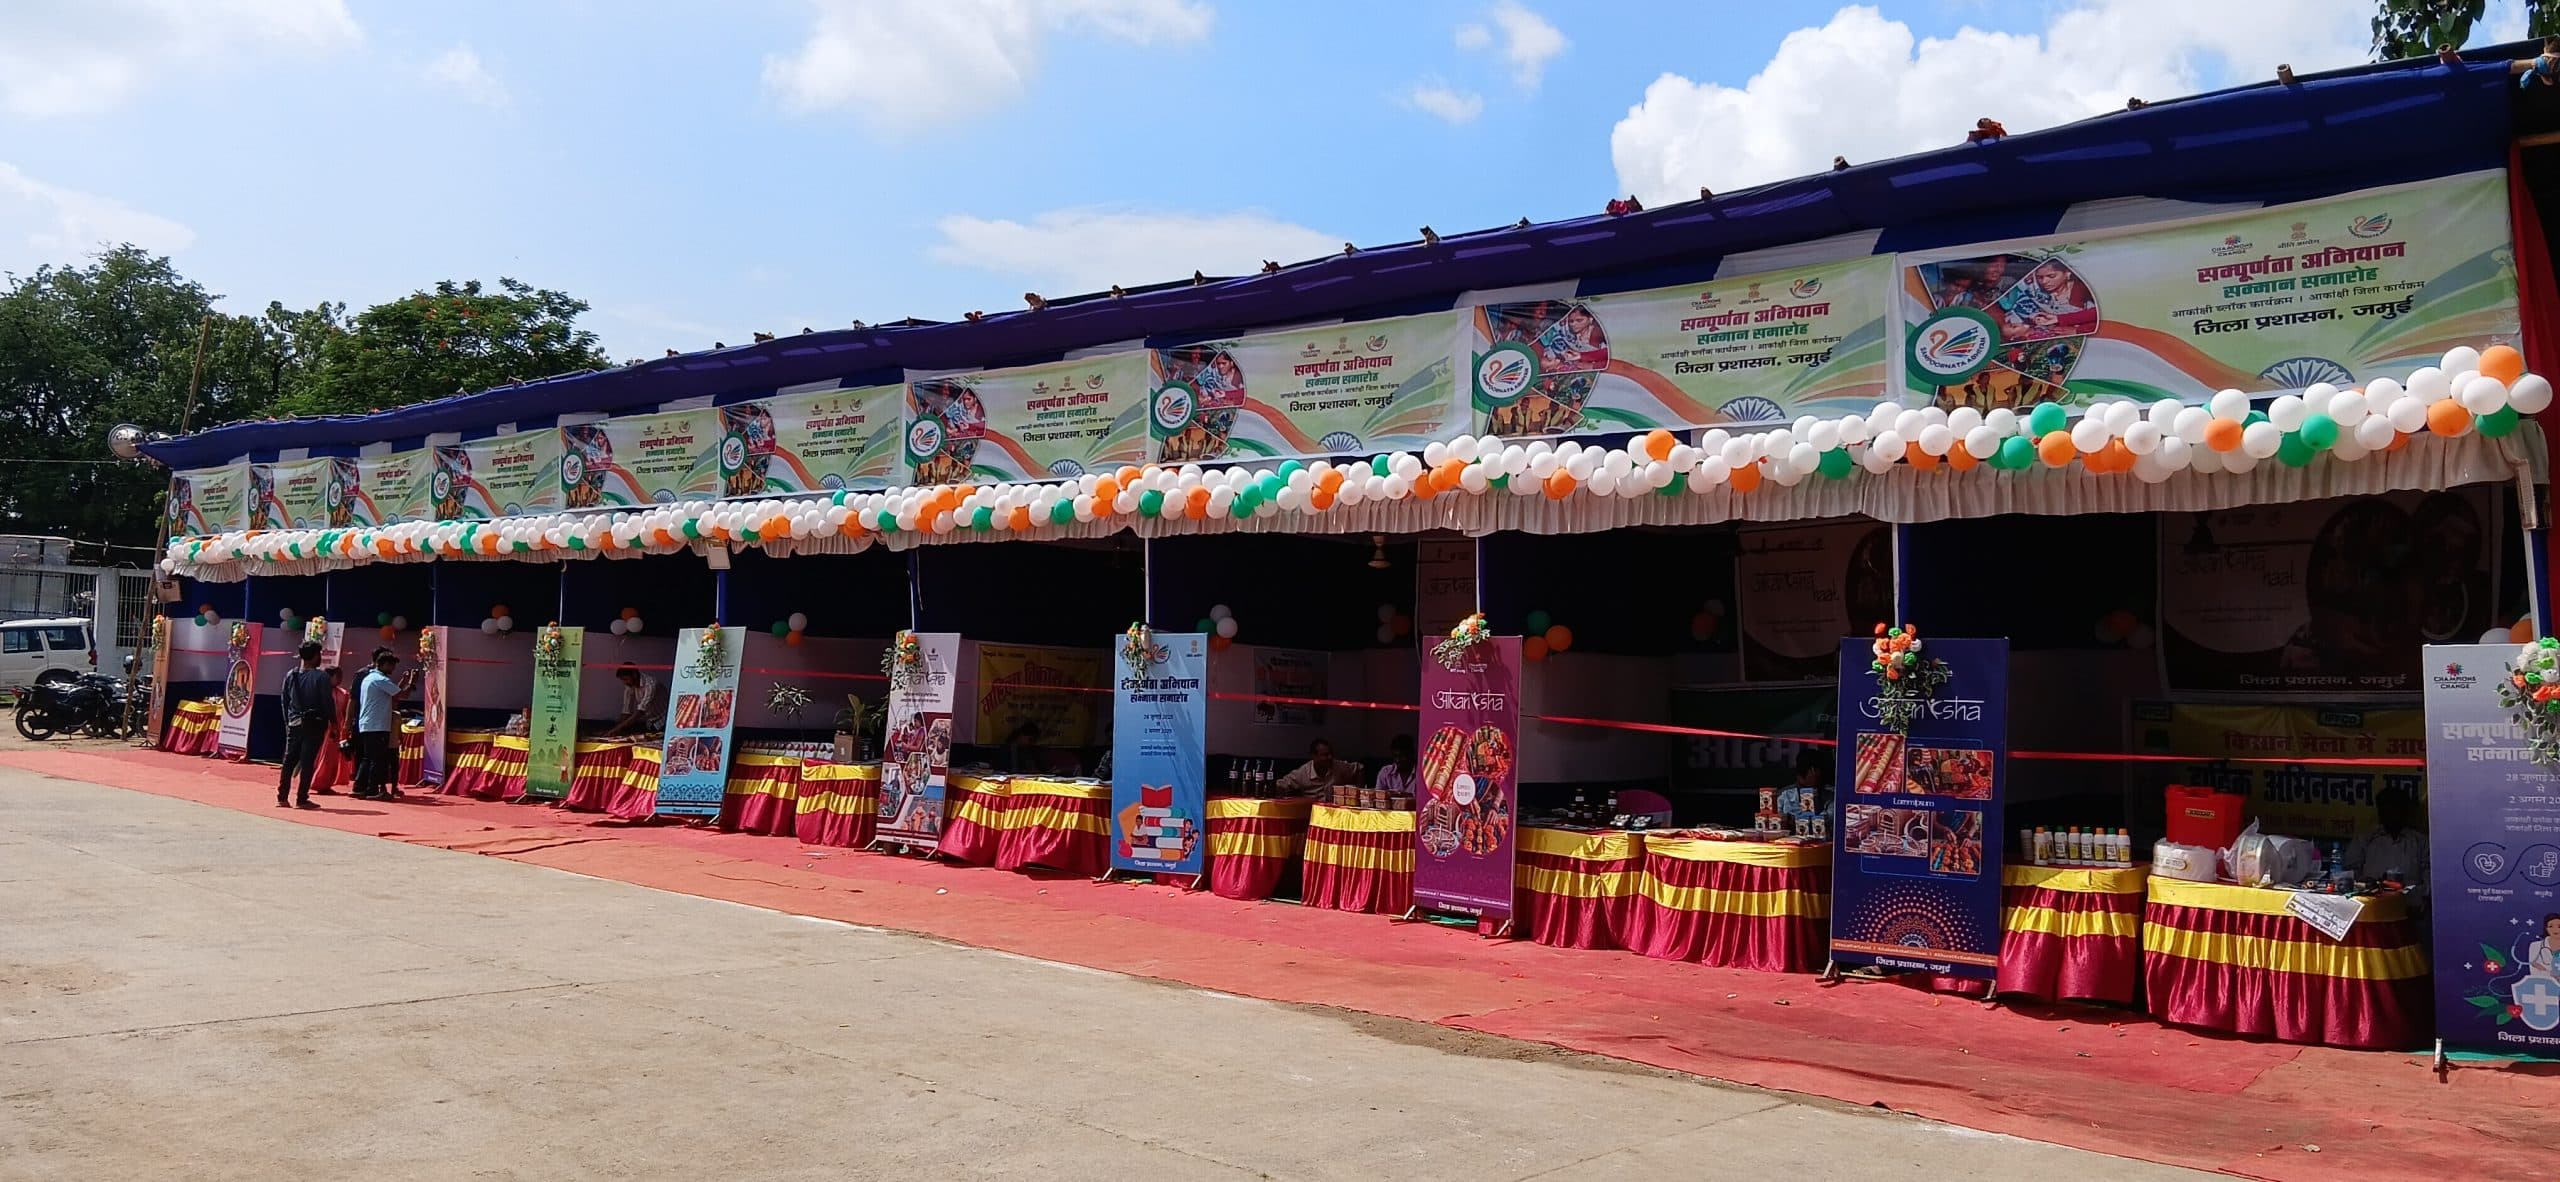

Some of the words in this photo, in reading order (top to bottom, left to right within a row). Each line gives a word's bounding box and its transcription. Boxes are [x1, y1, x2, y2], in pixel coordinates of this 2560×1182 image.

[2197, 254, 2294, 283] सम्पूर्णता
[2301, 240, 2408, 269] अभियान
[2222, 277, 2296, 298] सम्मान
[2301, 265, 2379, 290] समारोह
[2352, 284, 2380, 297] जिला
[1680, 309, 1750, 333] सम्पूर्णता
[1754, 301, 1831, 323] अभियान
[2193, 318, 2250, 336] जिला
[2254, 307, 2344, 330] प्रशासन,
[2351, 294, 2415, 319] जमुई
[1697, 327, 1749, 346] सम्मान
[1752, 321, 1810, 340] समारोह
[1343, 354, 1394, 371] अभियान
[1675, 360, 1714, 375] जिला
[1718, 354, 1782, 373] प्रशासन,
[1788, 347, 1833, 368] जमुई
[2498, 1031, 2525, 1042] जिला
